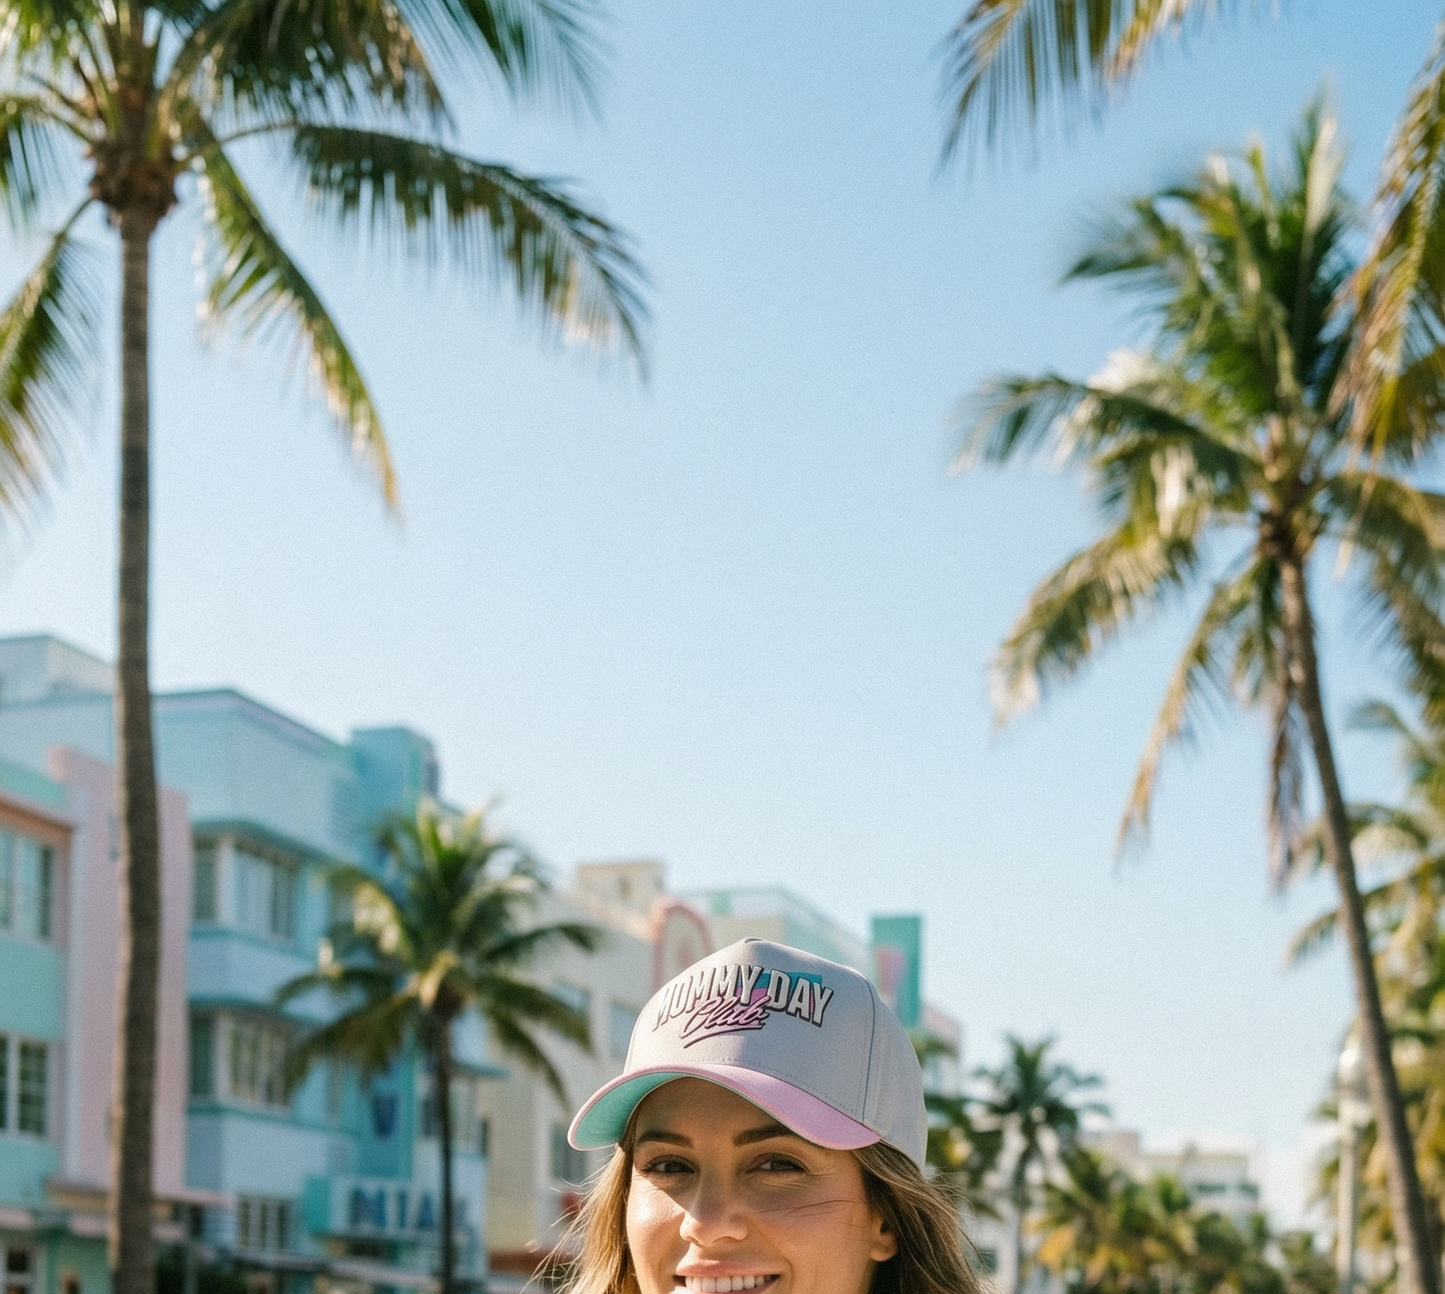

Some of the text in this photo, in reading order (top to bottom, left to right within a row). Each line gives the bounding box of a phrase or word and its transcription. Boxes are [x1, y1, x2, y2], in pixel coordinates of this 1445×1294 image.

[652, 963, 834, 1031] MOMMY DAY
[680, 995, 772, 1039] Club
